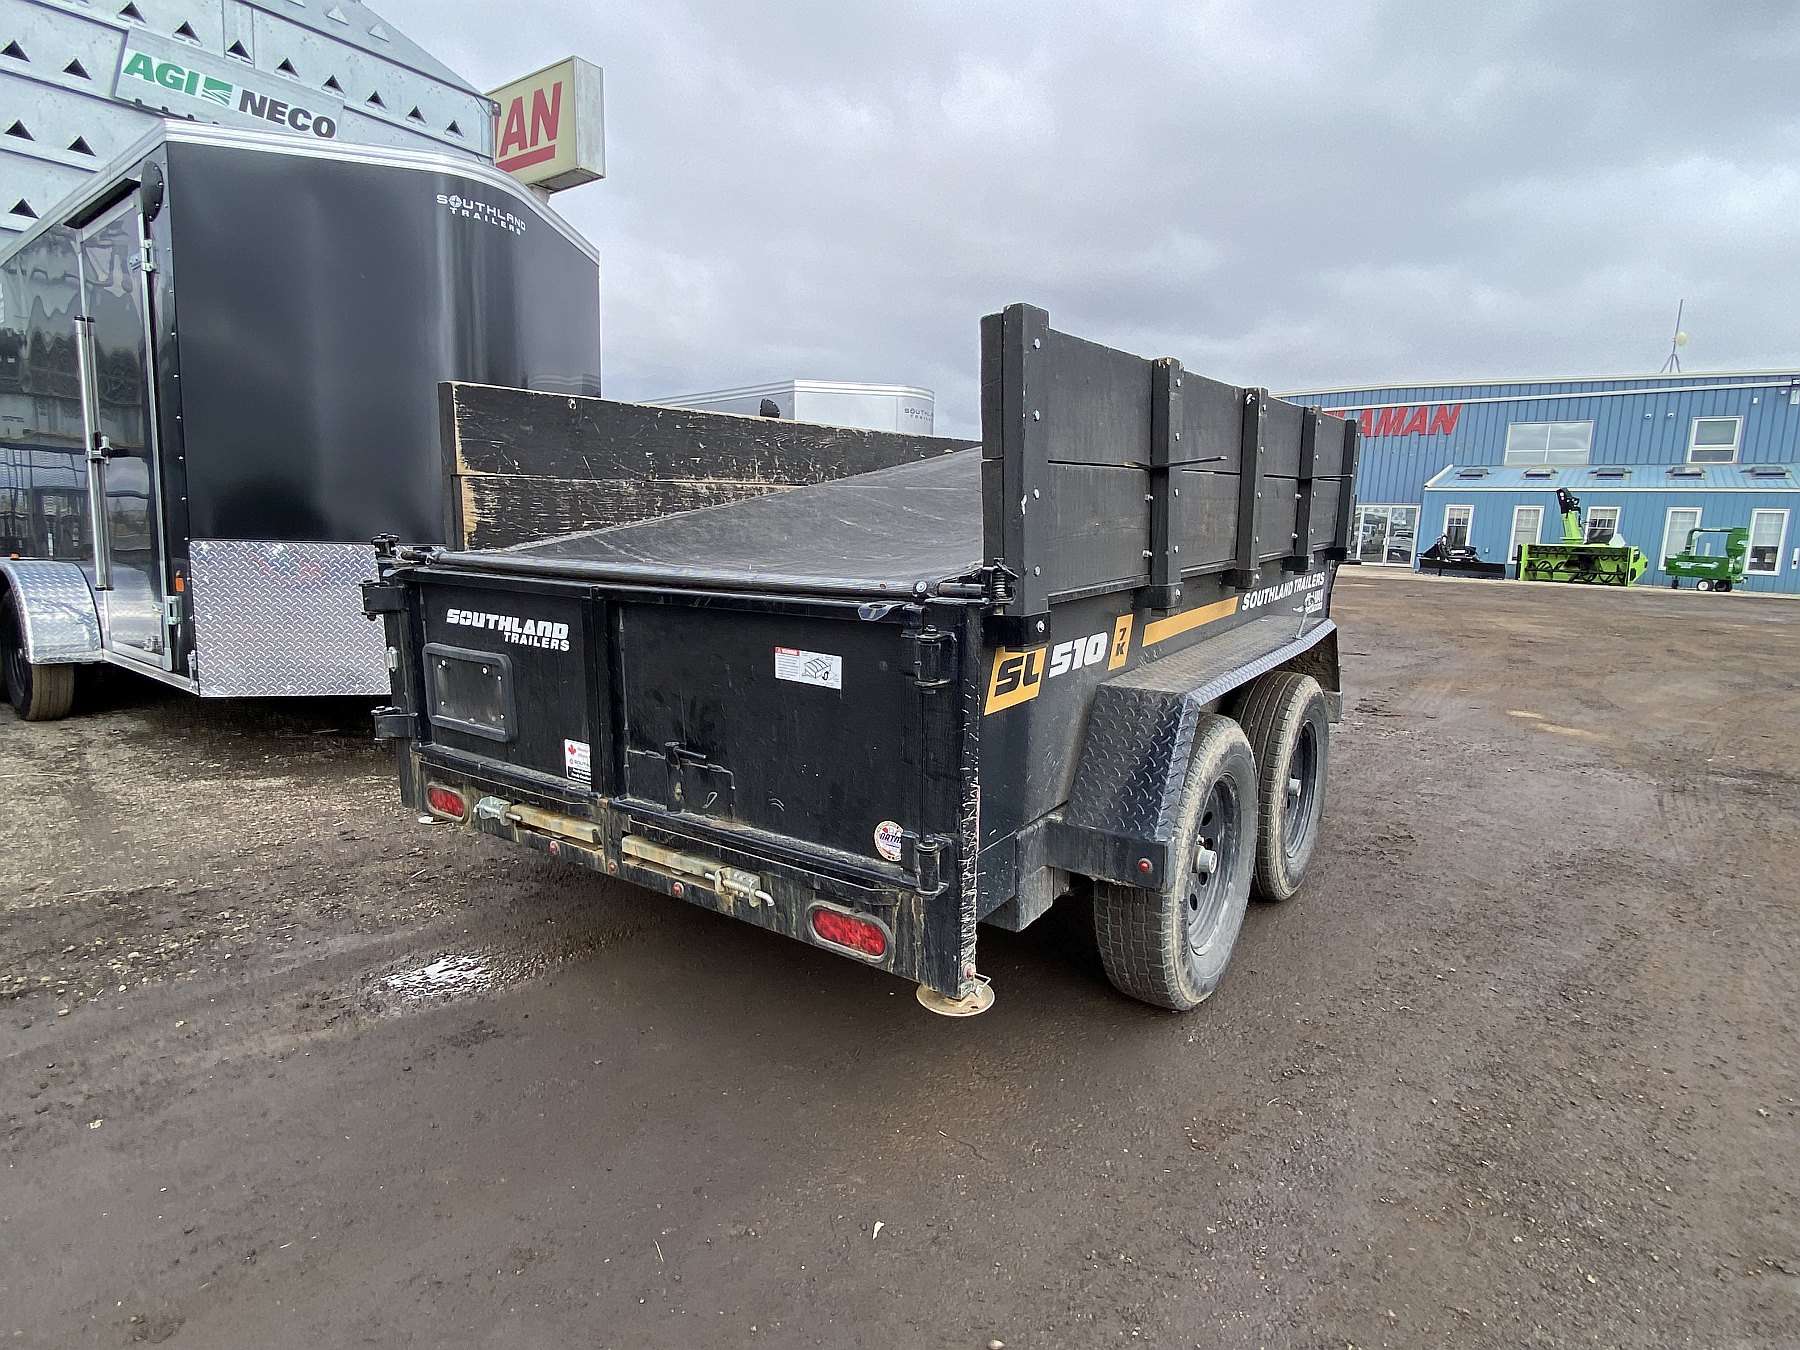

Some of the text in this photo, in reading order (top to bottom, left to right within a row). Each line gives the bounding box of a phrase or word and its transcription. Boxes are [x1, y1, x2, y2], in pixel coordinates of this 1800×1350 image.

[123, 52, 336, 138] AGI NECO
[495, 80, 563, 157] AN
[436, 194, 526, 231] SOUTHLAND
[449, 207, 521, 235] TRAILERS
[1327, 403, 1462, 437] AMAN
[1242, 580, 1293, 611] SOUTHLAND
[1294, 571, 1325, 593] TRAILERS
[446, 608, 569, 640] SOUTHLAND
[503, 631, 570, 652] TRAILERS
[994, 652, 1039, 697] SL
[1048, 631, 1108, 678] 510
